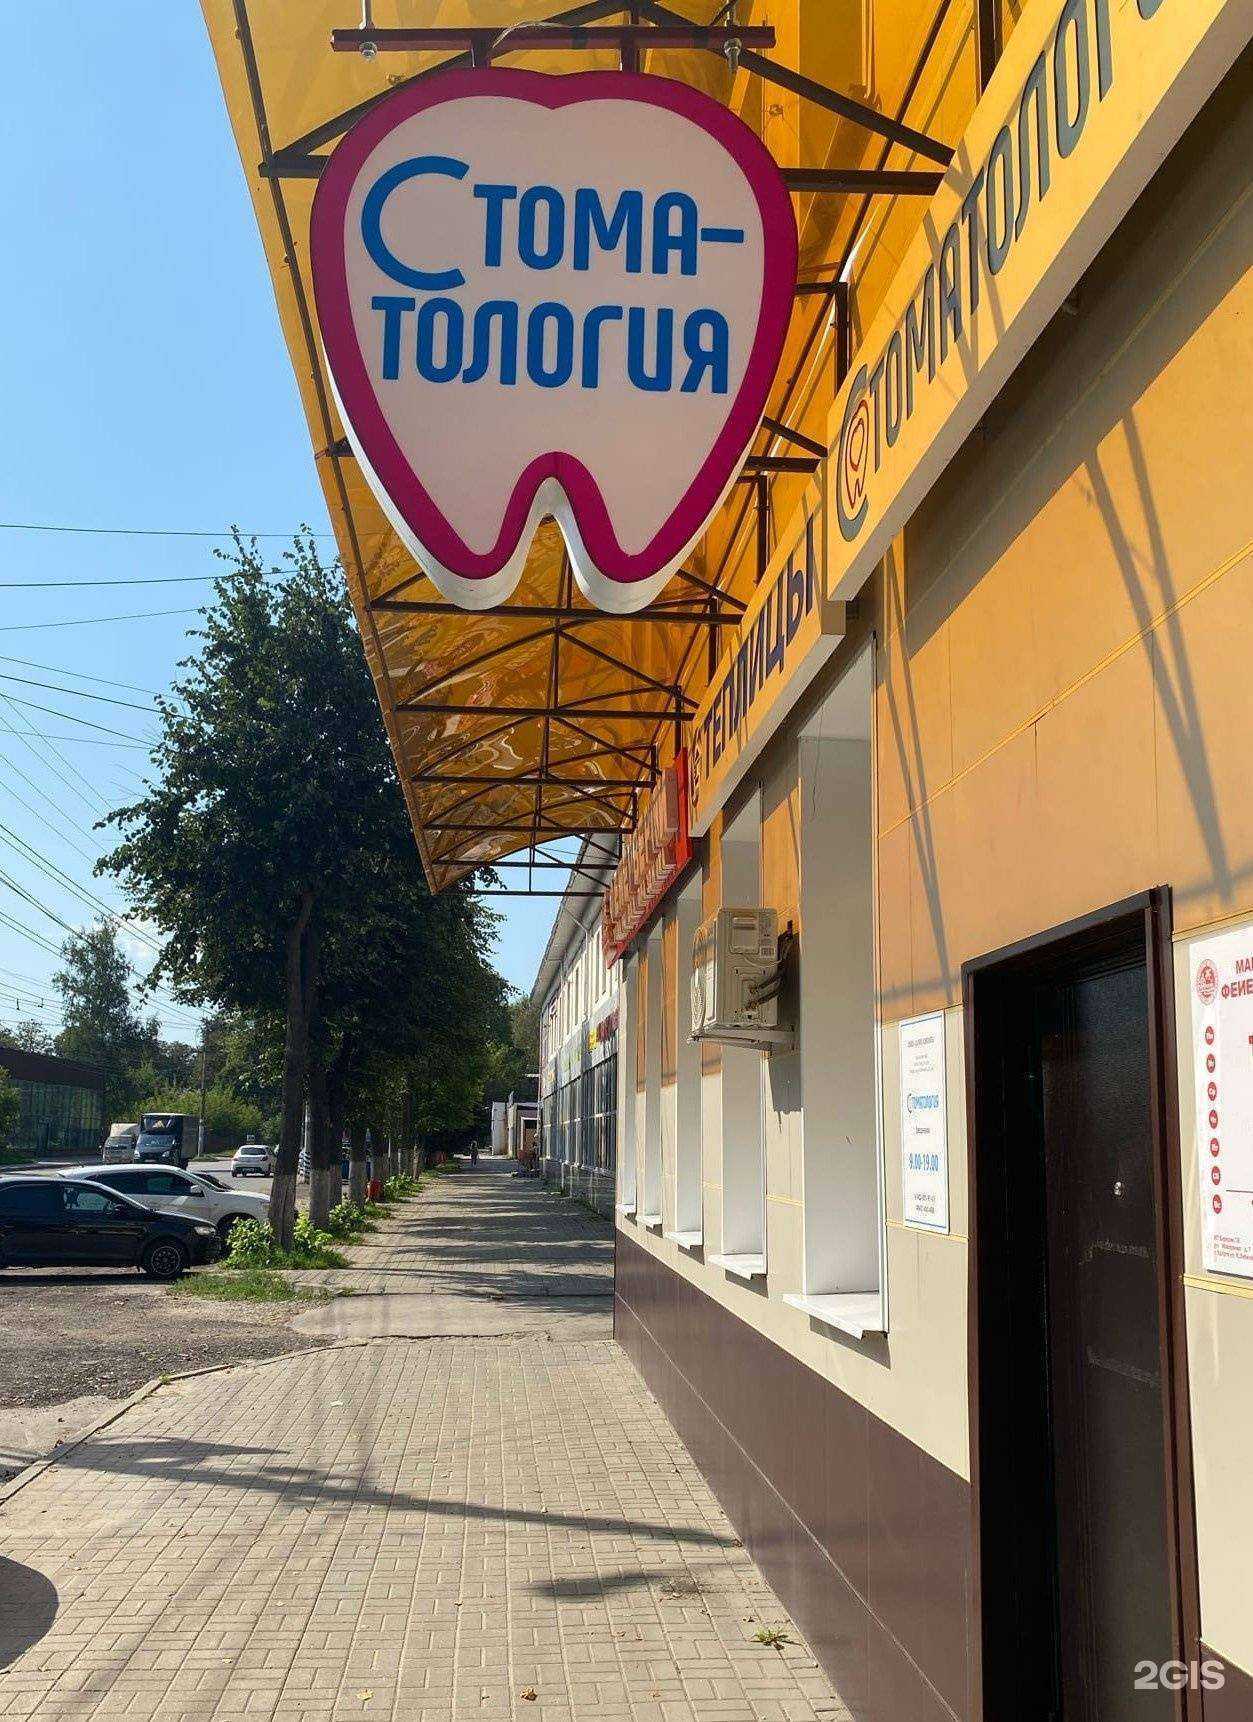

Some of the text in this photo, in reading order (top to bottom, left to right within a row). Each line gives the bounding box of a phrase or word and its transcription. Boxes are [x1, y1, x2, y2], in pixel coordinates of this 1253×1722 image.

[361, 155, 744, 291] СТОМА-
[371, 296, 729, 394] ТОЛОГИЯ
[703, 512, 814, 780] ТЕПЛИЦЫ
